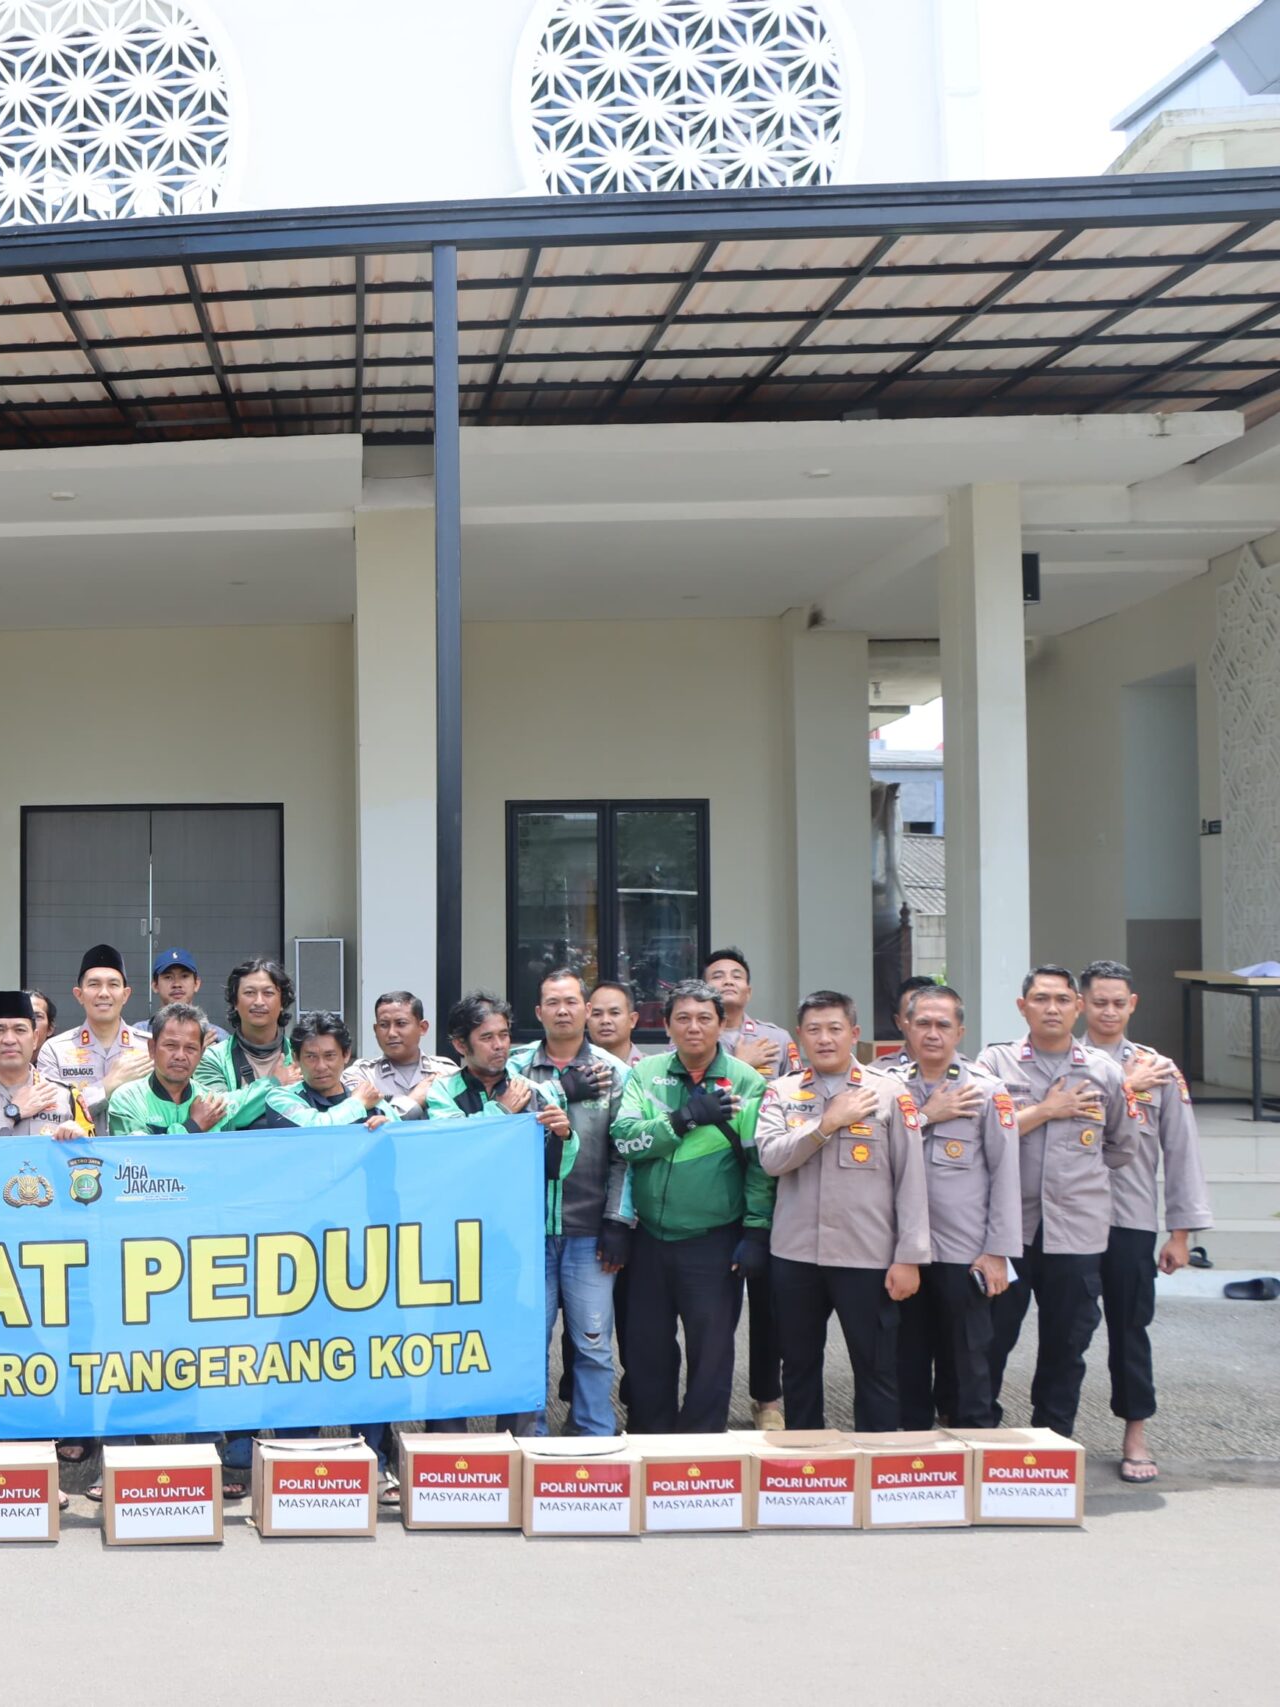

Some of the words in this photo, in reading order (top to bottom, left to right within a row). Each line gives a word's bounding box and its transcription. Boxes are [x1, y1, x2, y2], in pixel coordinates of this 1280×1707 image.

[62, 1067, 94, 1077] EKOBAGUS
[652, 1075, 678, 1087] Grab
[582, 1099, 610, 1109] Grab
[787, 1102, 815, 1112] ANDY
[33, 1112, 61, 1123] POLRI
[615, 1131, 654, 1155] Grab
[114, 1164, 148, 1181] JAGA
[122, 1219, 485, 1326] PEDULI
[71, 1336, 357, 1394] TANGERANG
[368, 1330, 491, 1380] KOTA
[419, 1472, 456, 1484] POLRI
[458, 1472, 502, 1484] UNTUK
[877, 1473, 913, 1485] POLRI
[915, 1470, 958, 1482] UNTUK
[988, 1467, 1024, 1479] POLRI
[1026, 1467, 1069, 1480] UNTUK
[279, 1478, 316, 1490] POLRI
[318, 1478, 362, 1490] UNTUK
[540, 1482, 577, 1494] POLRI
[579, 1482, 624, 1494] UNTUK
[652, 1480, 689, 1491] POLRI
[691, 1478, 735, 1490] UNTUK
[766, 1476, 802, 1488] POLRI
[804, 1476, 848, 1488] UNTUK
[121, 1487, 158, 1499] POLRI
[160, 1486, 205, 1498] UNTUK
[419, 1491, 502, 1502] MASYARAKAT
[877, 1489, 958, 1502] MASYARAKAT
[988, 1486, 1069, 1498] MASYARAKAT
[279, 1498, 362, 1509] MASYARAKAT
[540, 1501, 624, 1512] MASYARAKAT
[652, 1497, 735, 1509] MASYARAKAT
[766, 1495, 848, 1506] MASYARAKAT
[121, 1505, 205, 1517] MASYARAKAT
